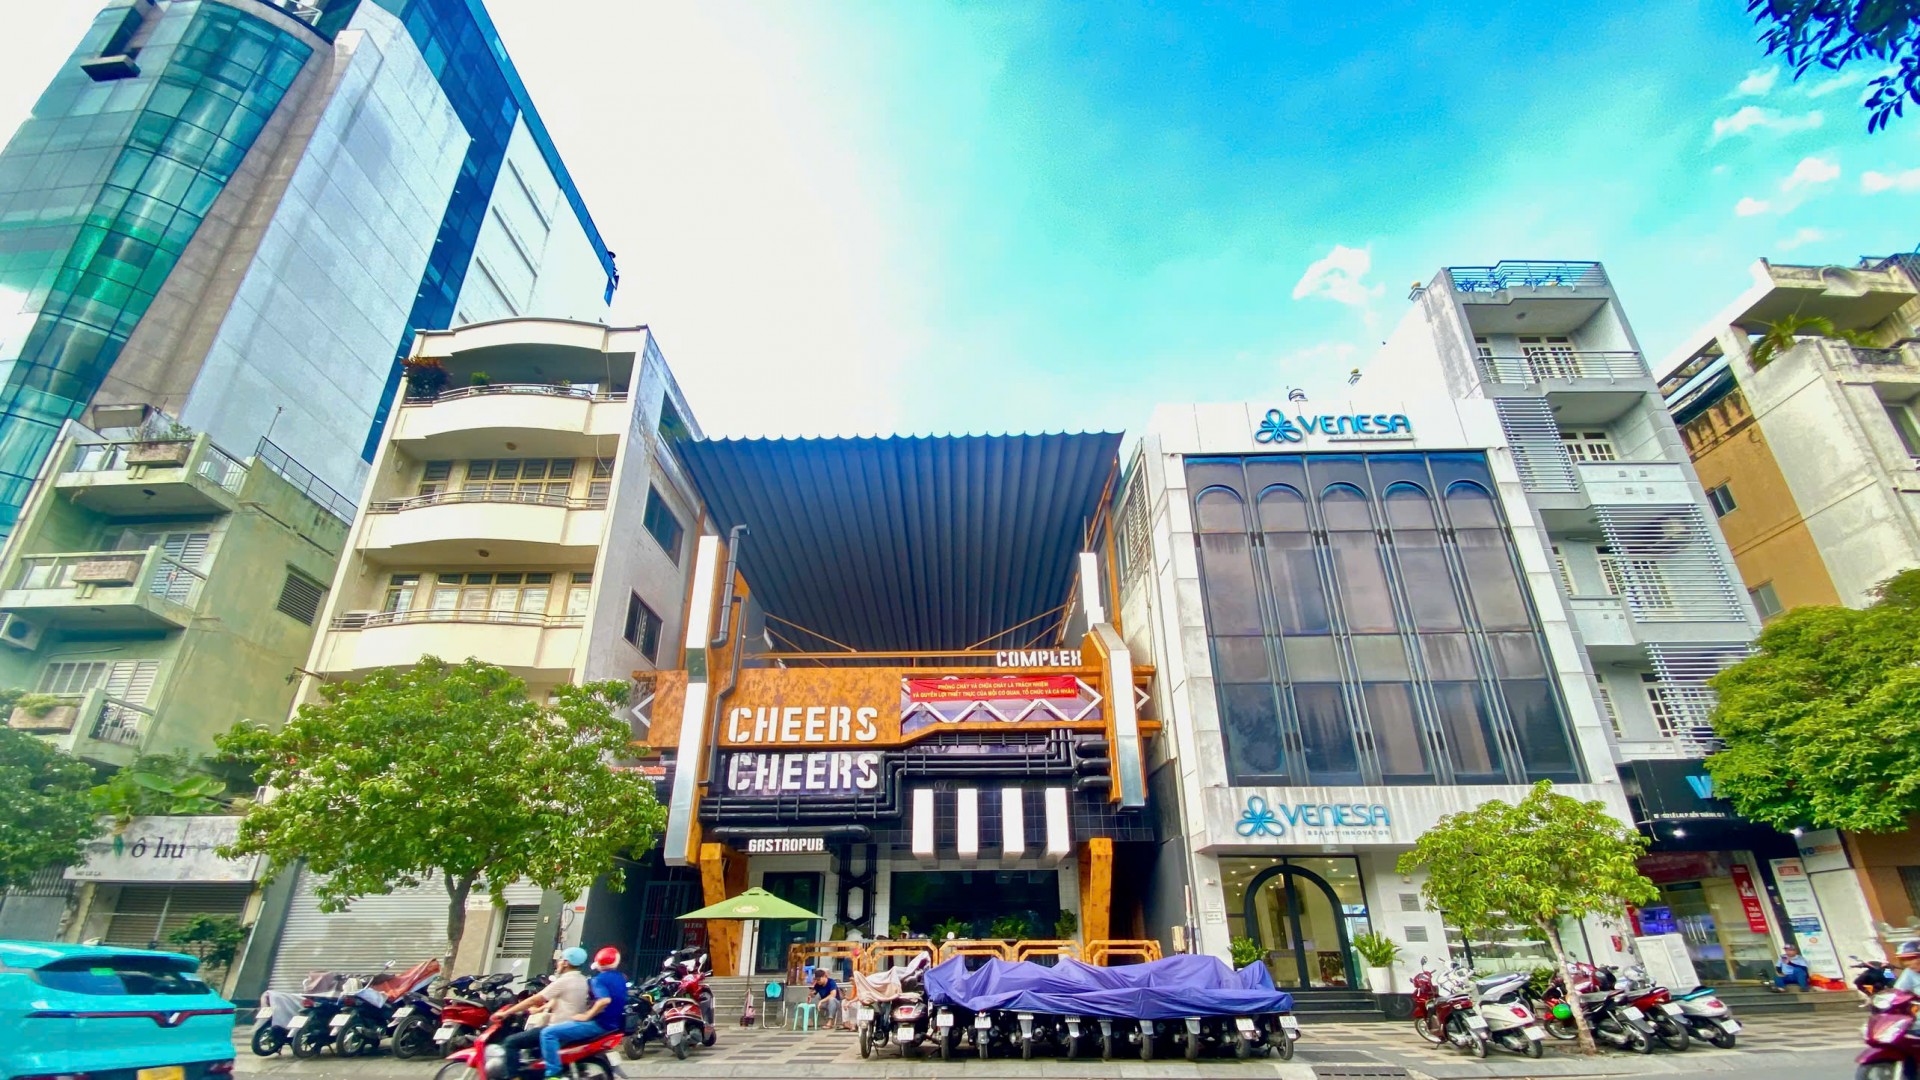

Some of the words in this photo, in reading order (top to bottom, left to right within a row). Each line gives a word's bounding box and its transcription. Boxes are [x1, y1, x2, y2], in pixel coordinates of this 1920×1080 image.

[1297, 414, 1411, 435] VENESA
[996, 650, 1082, 667] COMPLEX
[727, 706, 878, 743] CHEERS
[727, 753, 879, 791] CHEERS
[1279, 803, 1391, 827] VENESA
[748, 838, 824, 852] GASTROPUB
